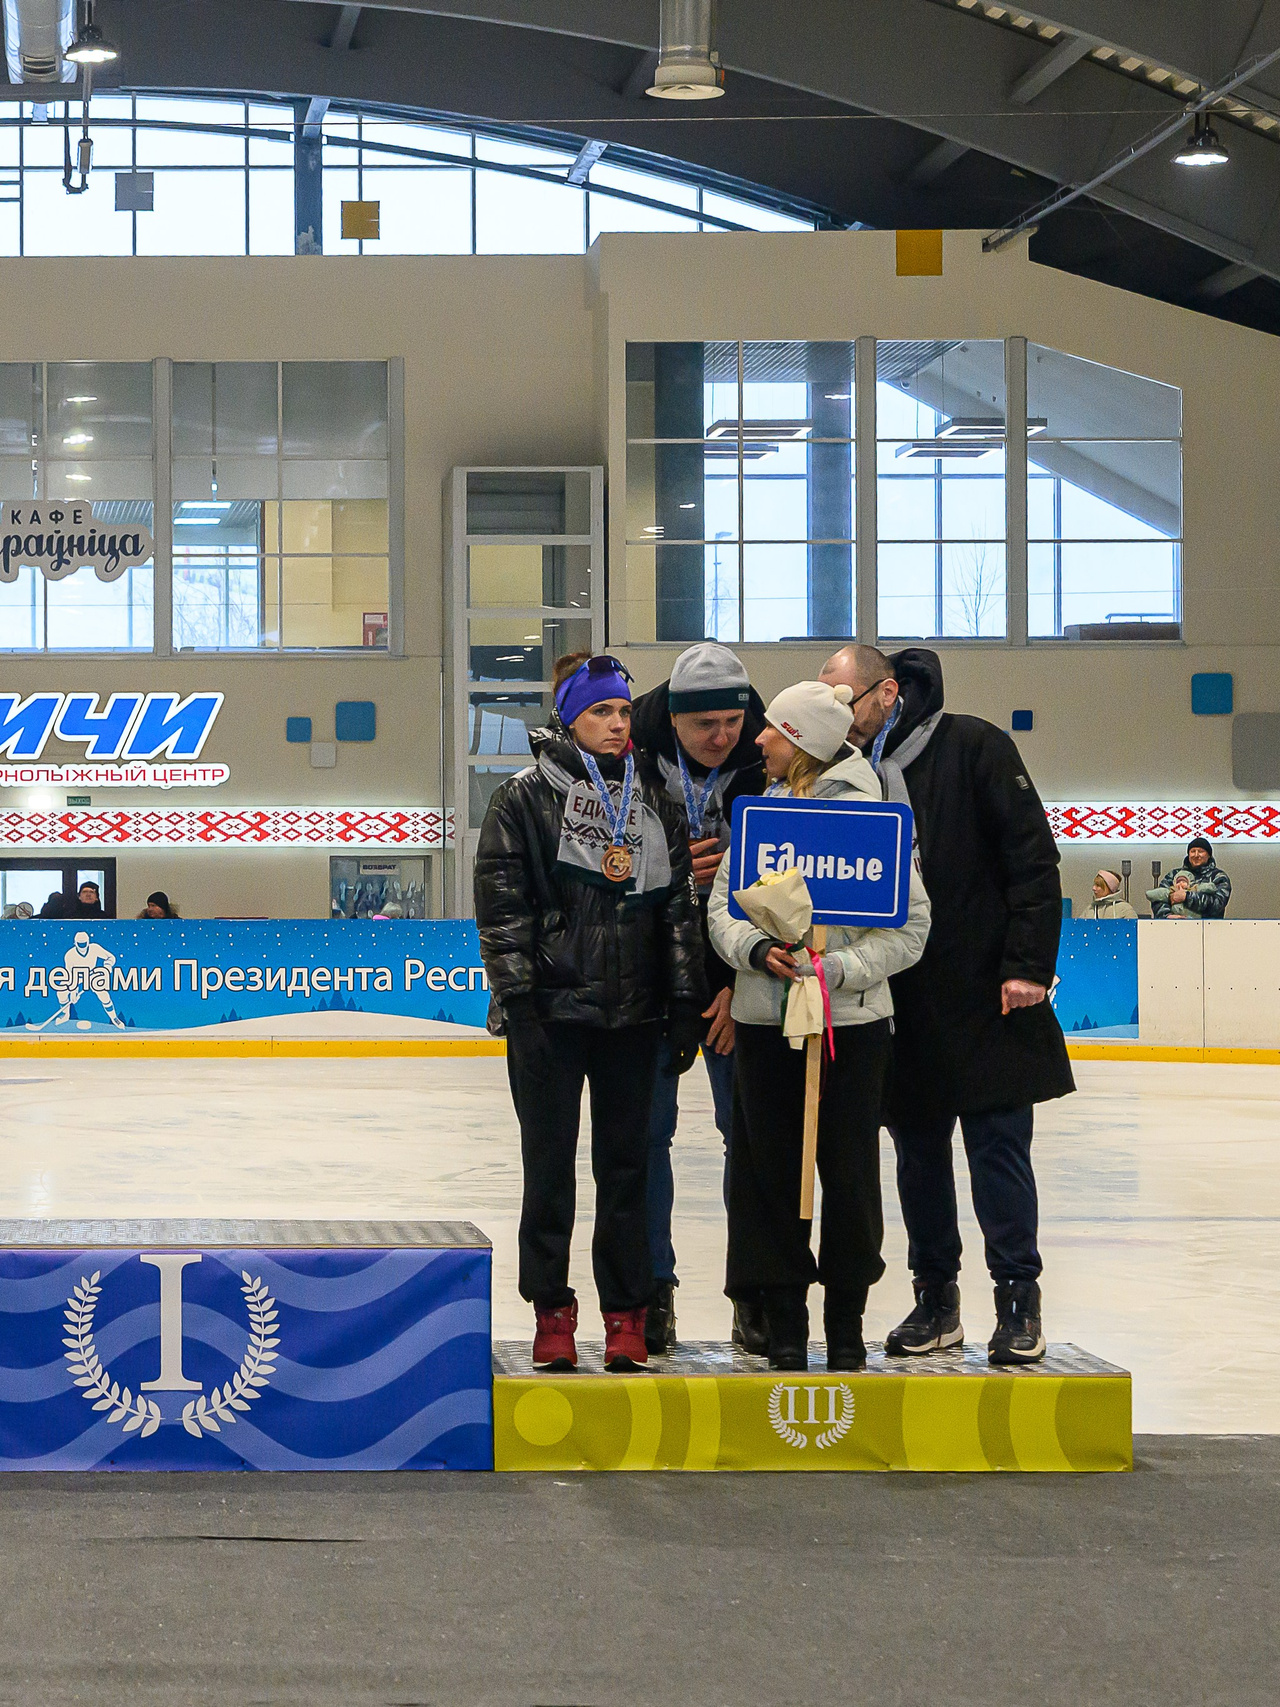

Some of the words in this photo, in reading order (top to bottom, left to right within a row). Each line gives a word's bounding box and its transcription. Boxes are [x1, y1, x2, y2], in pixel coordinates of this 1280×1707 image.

[10, 508, 83, 525] КАФЕ
[153, 768, 225, 784] ЦЕНТР
[573, 795, 637, 826] ЕДИЕ
[756, 842, 883, 882] Единые
[24, 966, 162, 998] делами
[173, 958, 393, 1000] Президента
[404, 958, 490, 992] Респ
